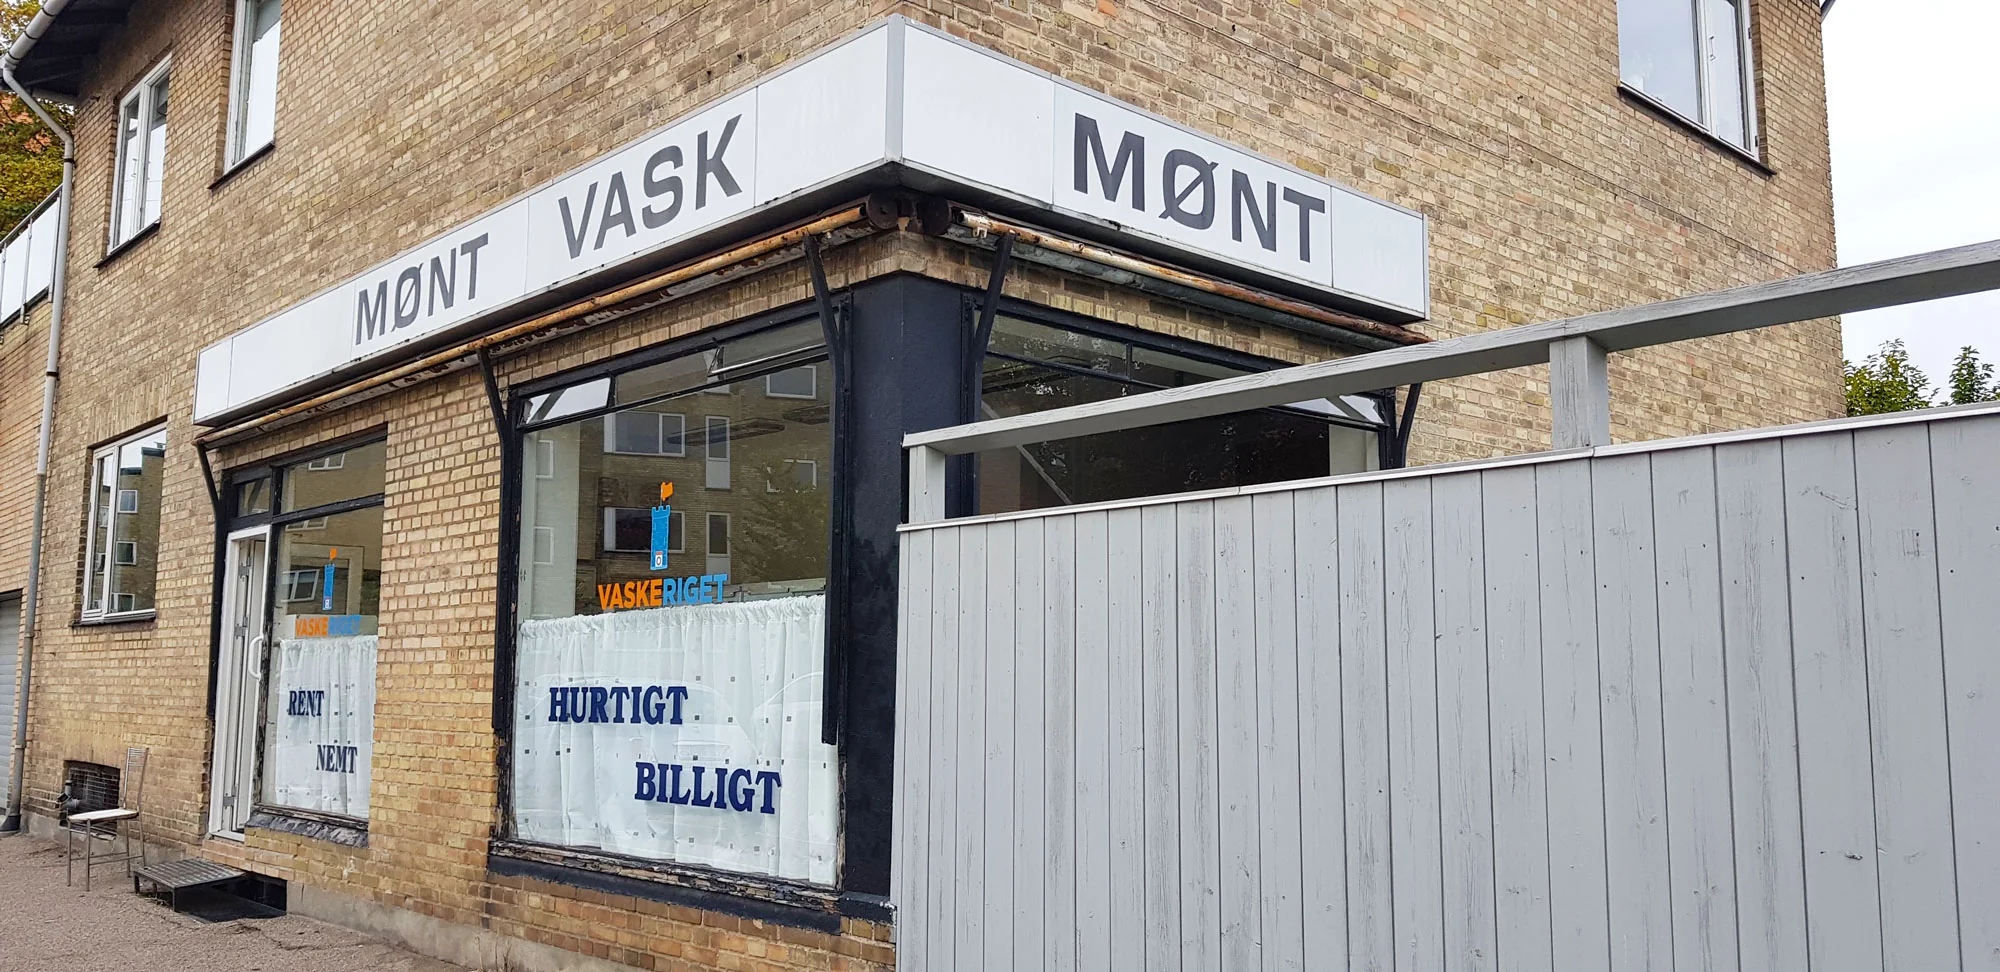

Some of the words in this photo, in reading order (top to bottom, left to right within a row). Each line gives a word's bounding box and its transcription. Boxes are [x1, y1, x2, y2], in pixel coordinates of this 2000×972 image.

[1074, 113, 1325, 262] MØNT
[355, 233, 489, 345] MØNT
[558, 114, 742, 259] VASK
[597, 573, 728, 610] VASKERIGET
[287, 690, 324, 717] RENT
[548, 685, 688, 725] HURTIGT
[316, 744, 358, 774] NEMT
[634, 761, 782, 814] BILLIGT
